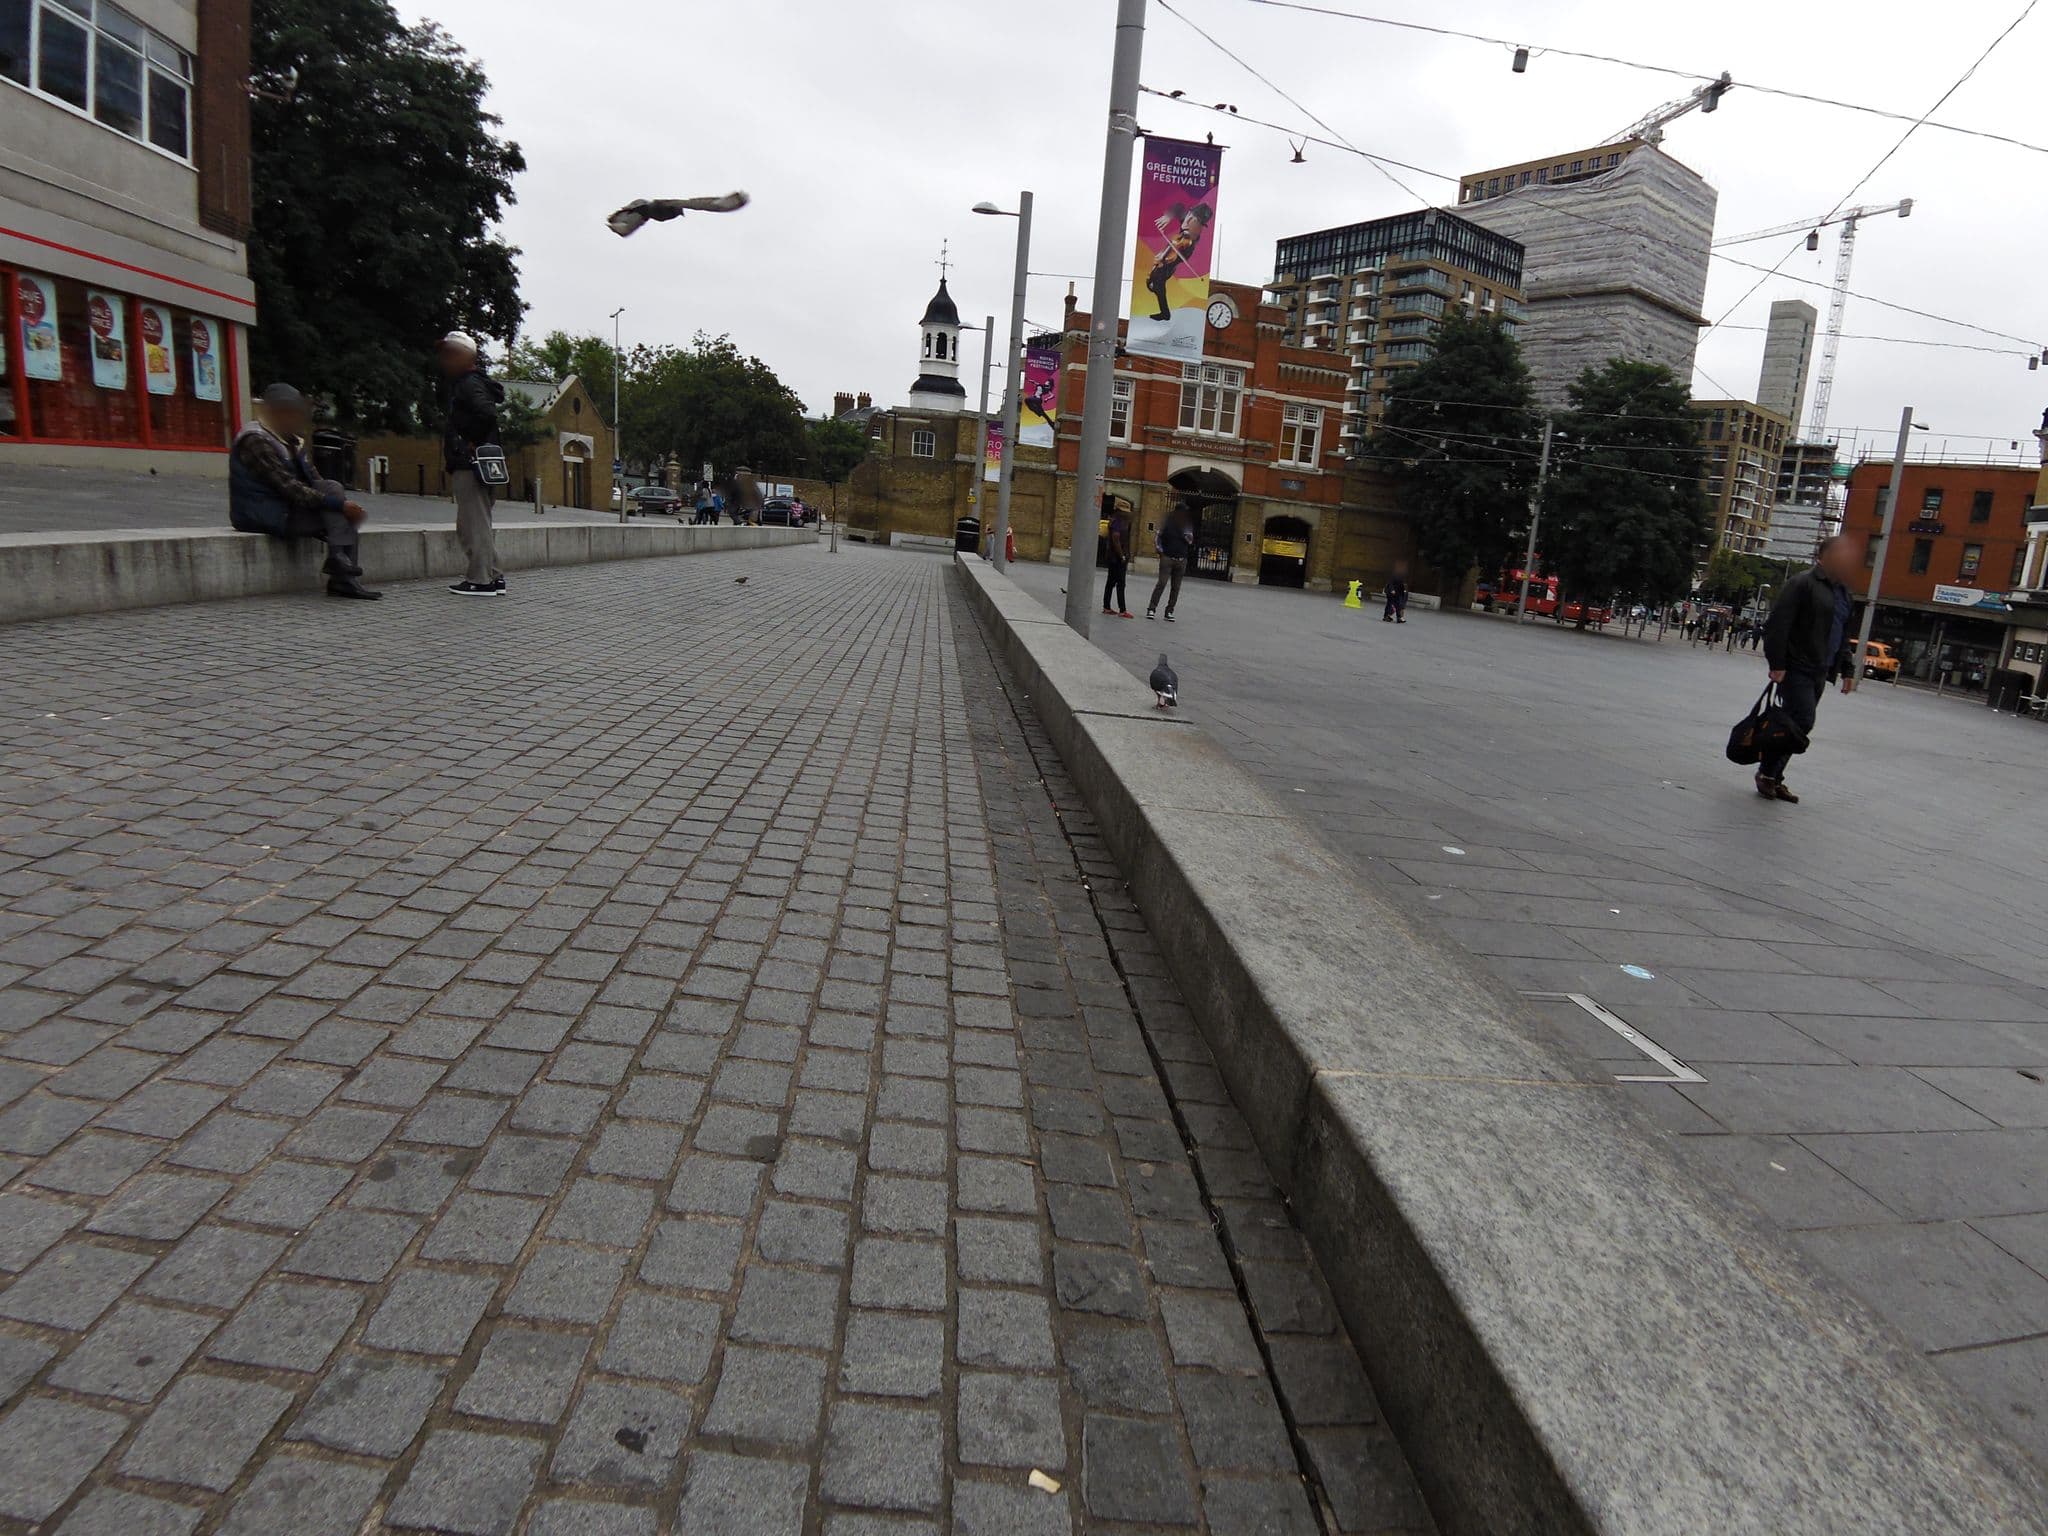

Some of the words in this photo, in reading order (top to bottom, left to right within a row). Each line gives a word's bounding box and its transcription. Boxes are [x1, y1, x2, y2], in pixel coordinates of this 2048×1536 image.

[1174, 156, 1207, 169] ROYAL
[1146, 161, 1207, 178] GREENWICH
[1152, 172, 1206, 187] FESTIVALS
[1935, 595, 1961, 604] CENTRE
[1937, 589, 1969, 599] TRAINING
